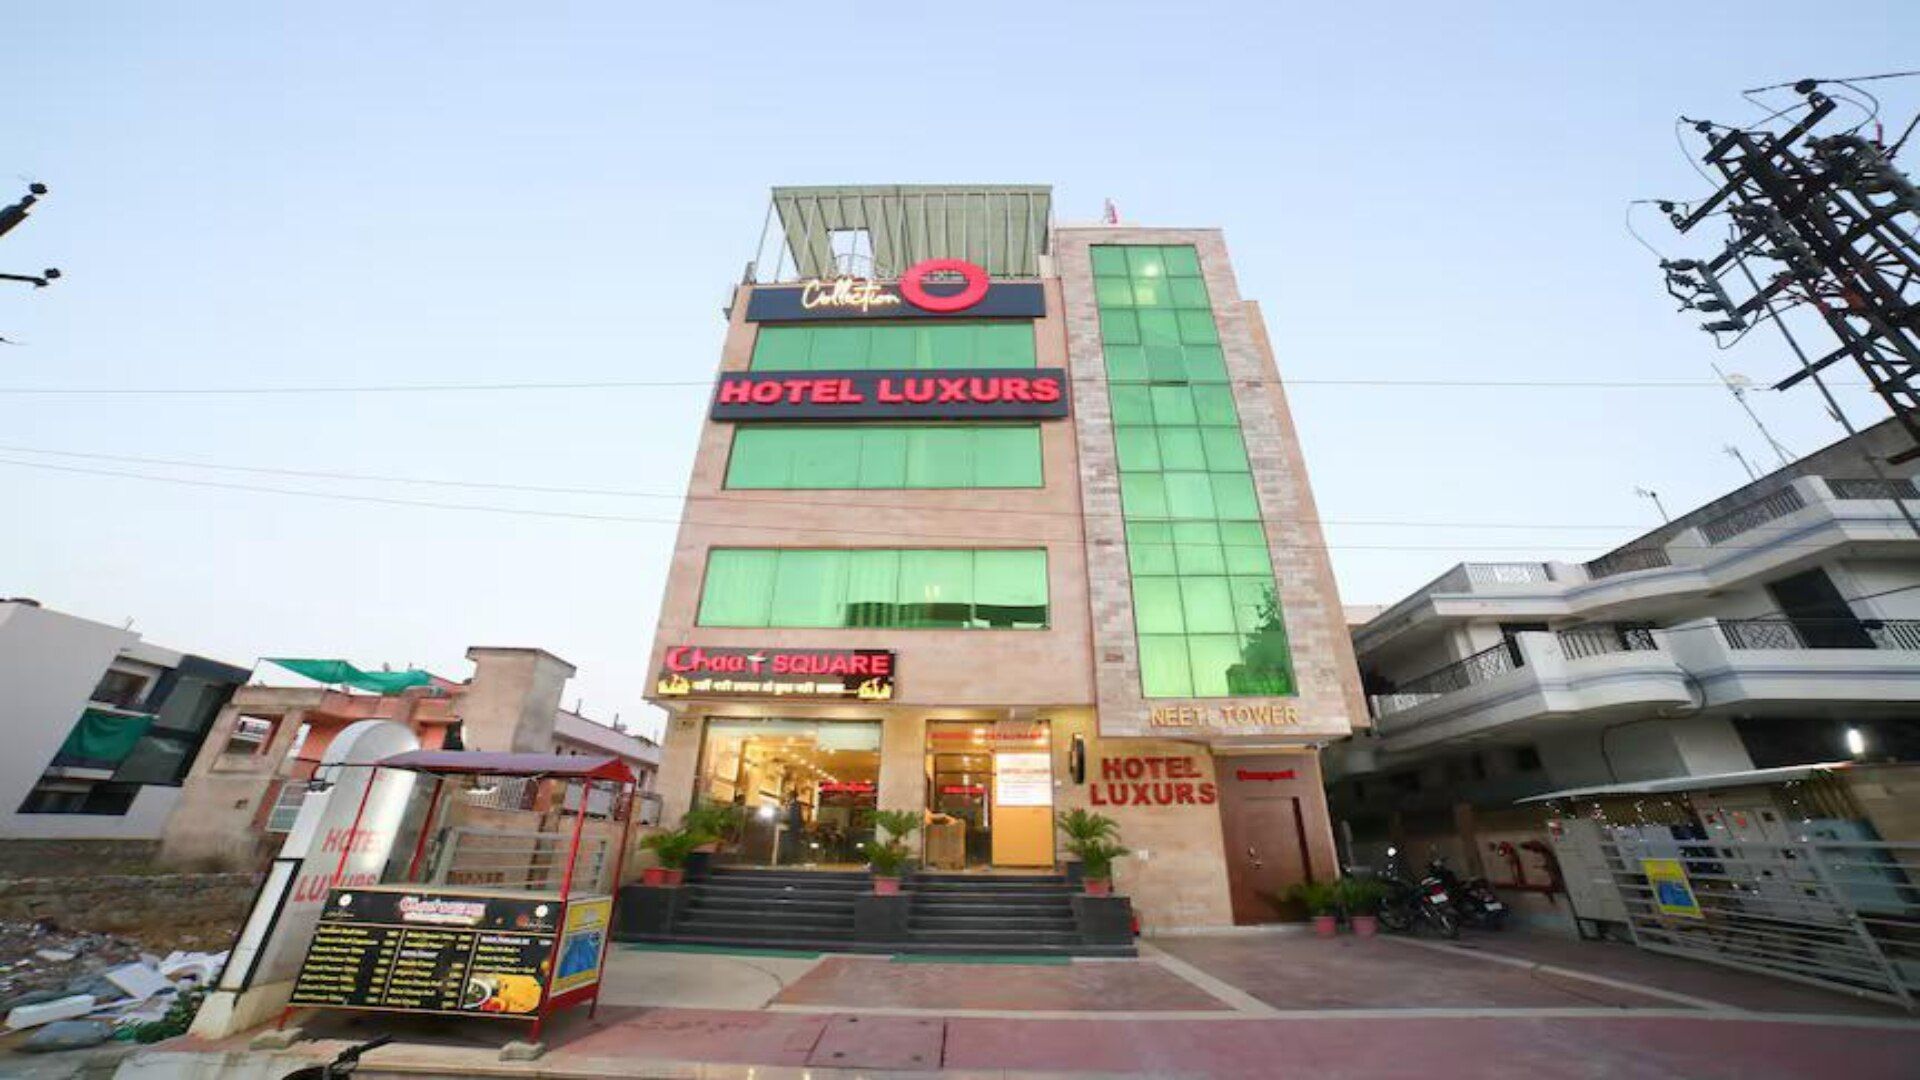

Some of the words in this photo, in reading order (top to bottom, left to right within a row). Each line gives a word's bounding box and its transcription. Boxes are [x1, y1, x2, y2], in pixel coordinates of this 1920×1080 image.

[801, 278, 900, 313] Collection
[719, 378, 863, 404] HOTEL
[876, 376, 1060, 403] LUXURS
[772, 653, 890, 676] SQUARE
[1220, 705, 1300, 726] TOWER
[1101, 757, 1202, 780] HOTEL
[1090, 782, 1217, 806] LUXURS
